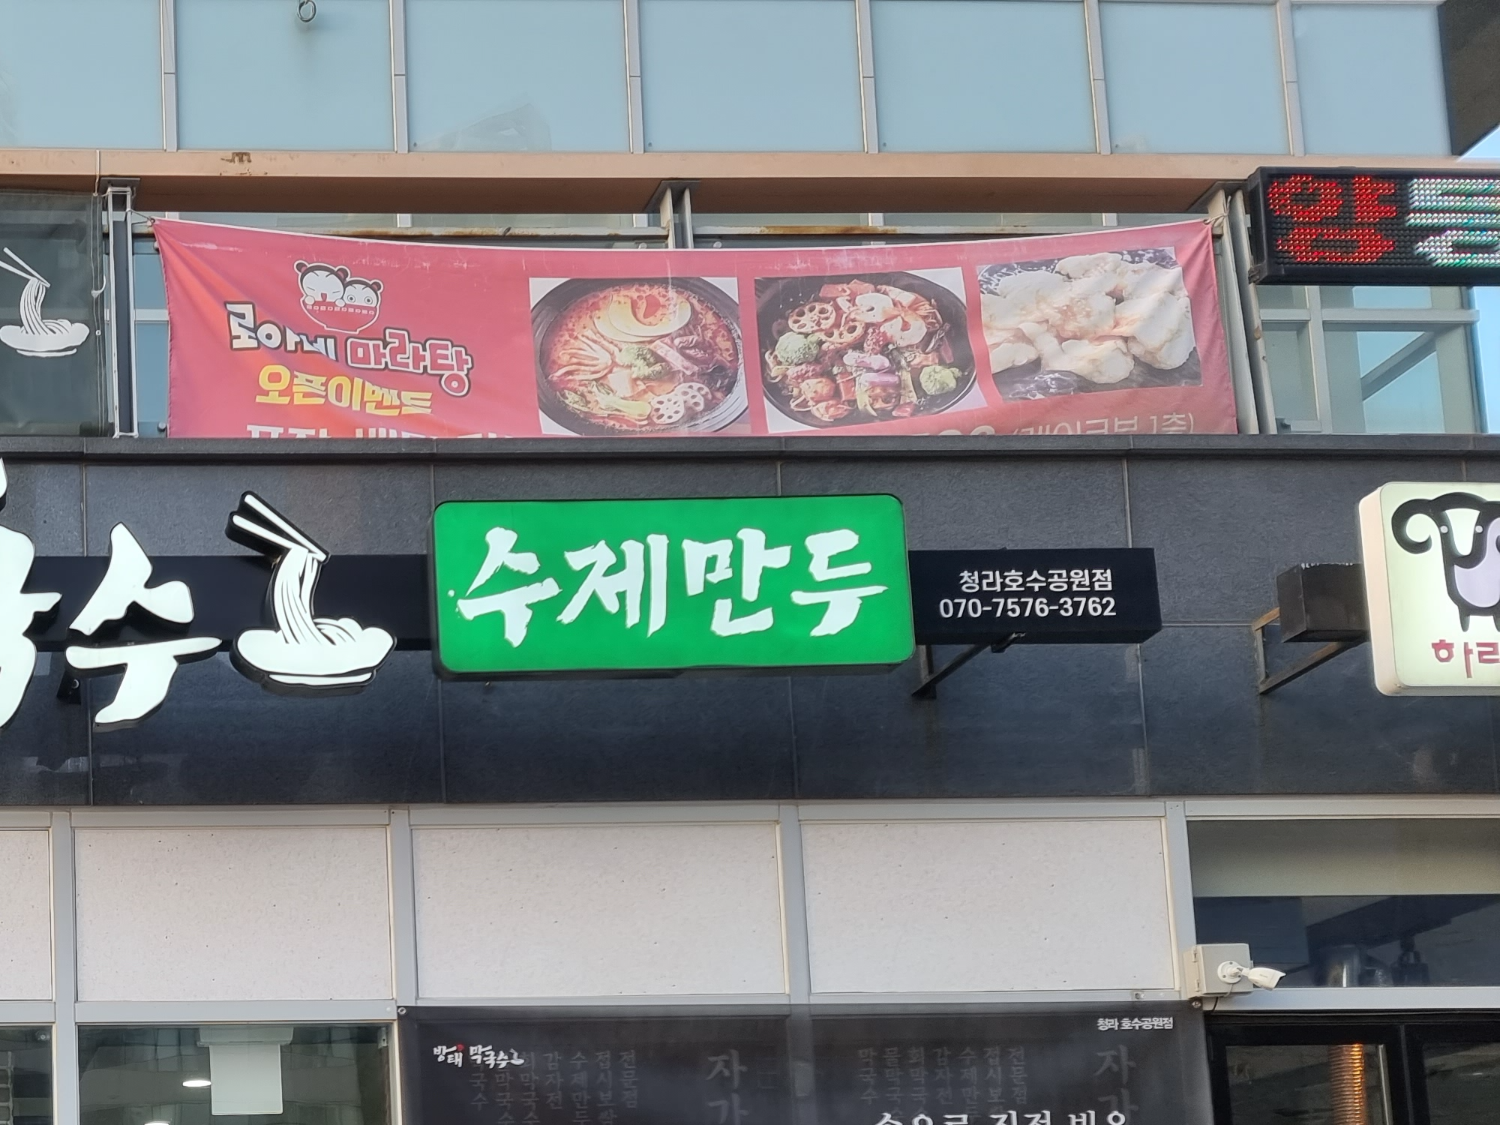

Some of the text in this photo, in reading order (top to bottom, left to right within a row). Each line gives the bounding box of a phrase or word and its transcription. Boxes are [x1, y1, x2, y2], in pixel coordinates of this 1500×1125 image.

[346, 328, 473, 396] 마라탕
[255, 365, 433, 417] 오픈이벤트
[457, 526, 888, 648] 수제만두
[958, 567, 1114, 593] 청라호수공원점
[939, 597, 1117, 621] 070-7576-3762
[1097, 1016, 1173, 1031] 청라 호수공원점
[433, 1044, 509, 1069] 방태 막국수
